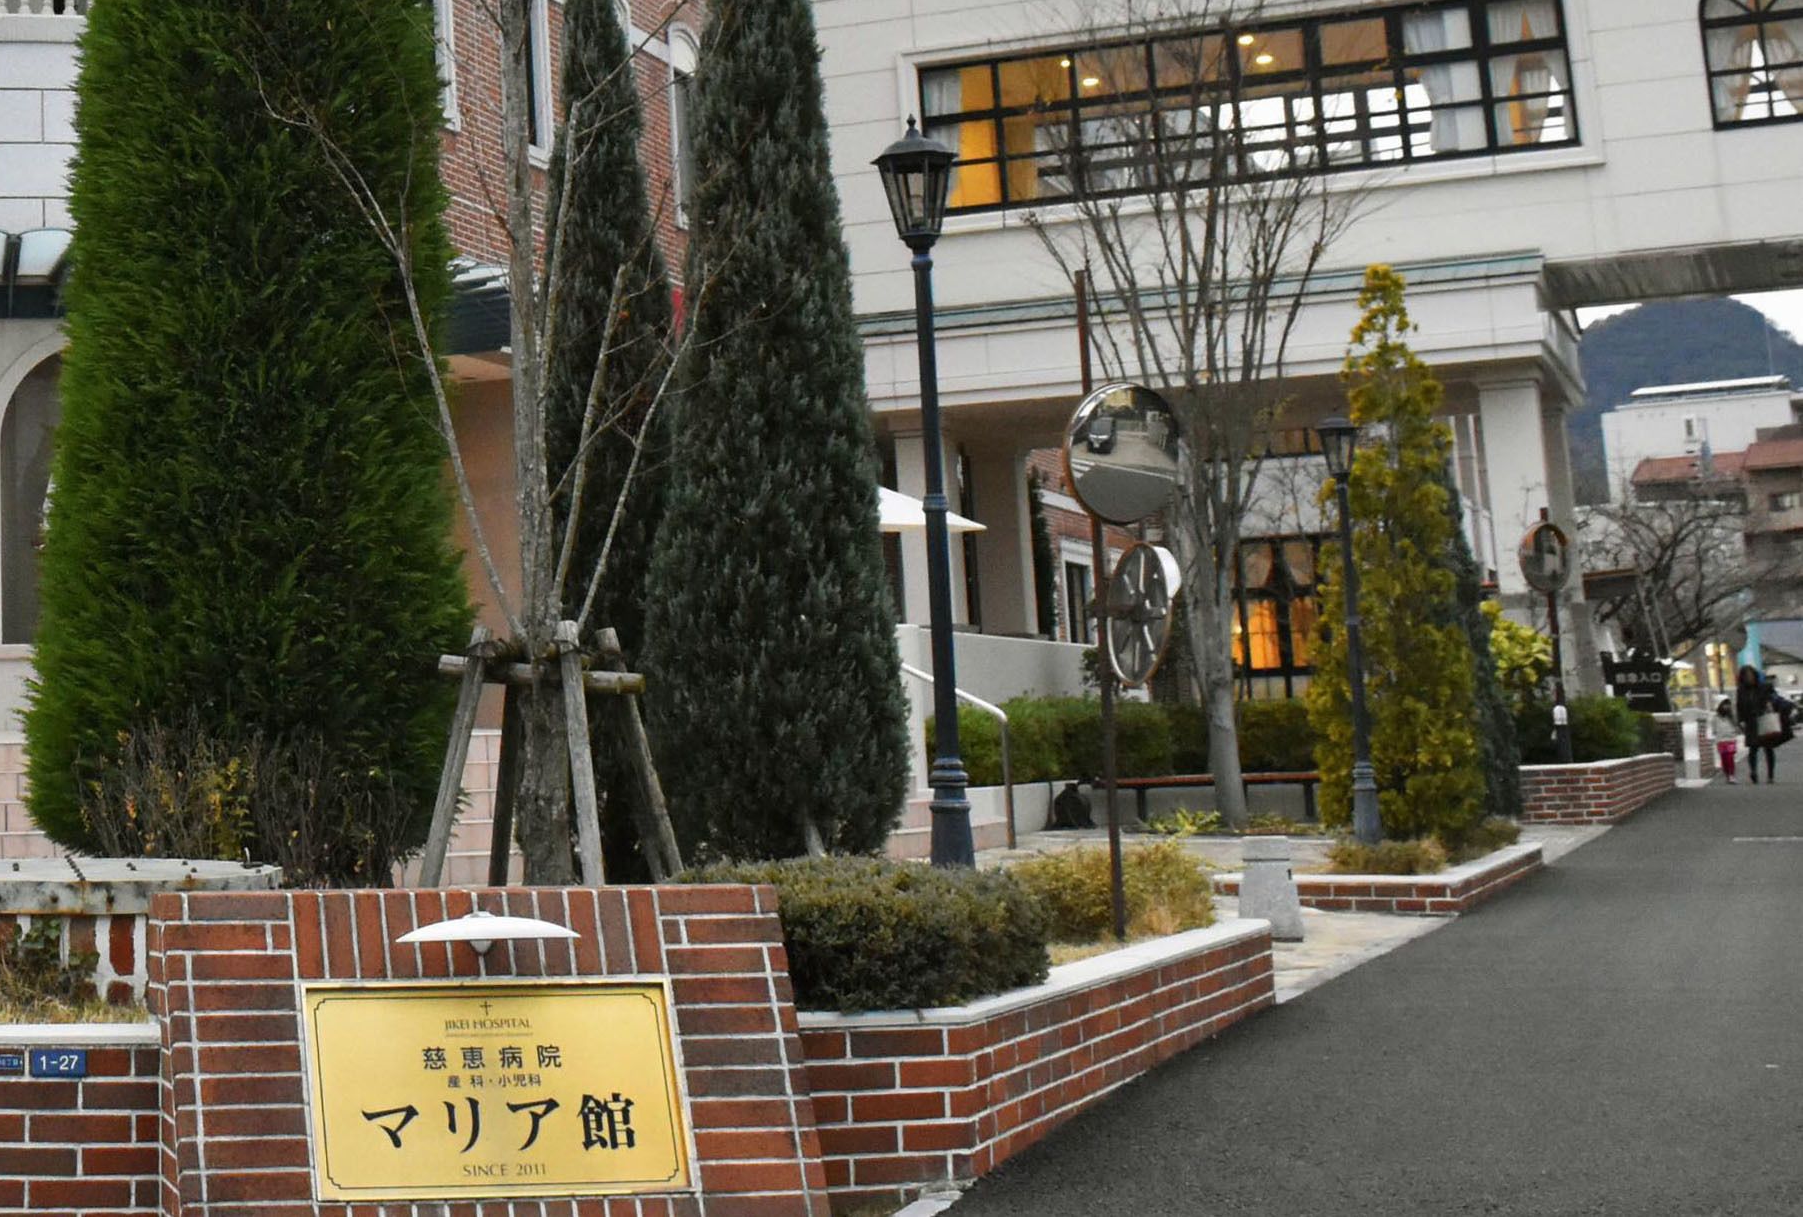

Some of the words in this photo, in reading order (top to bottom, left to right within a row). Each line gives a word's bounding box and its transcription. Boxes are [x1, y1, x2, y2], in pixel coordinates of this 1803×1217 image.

[444, 1018, 470, 1031] JIKEI
[473, 1017, 533, 1030] HOSPITAL
[39, 1054, 79, 1071] 1-27
[422, 1043, 562, 1070] 慈恵病院
[361, 1092, 636, 1153] マリア館
[463, 1163, 508, 1178] SINCE
[516, 1162, 547, 1176] 2011
